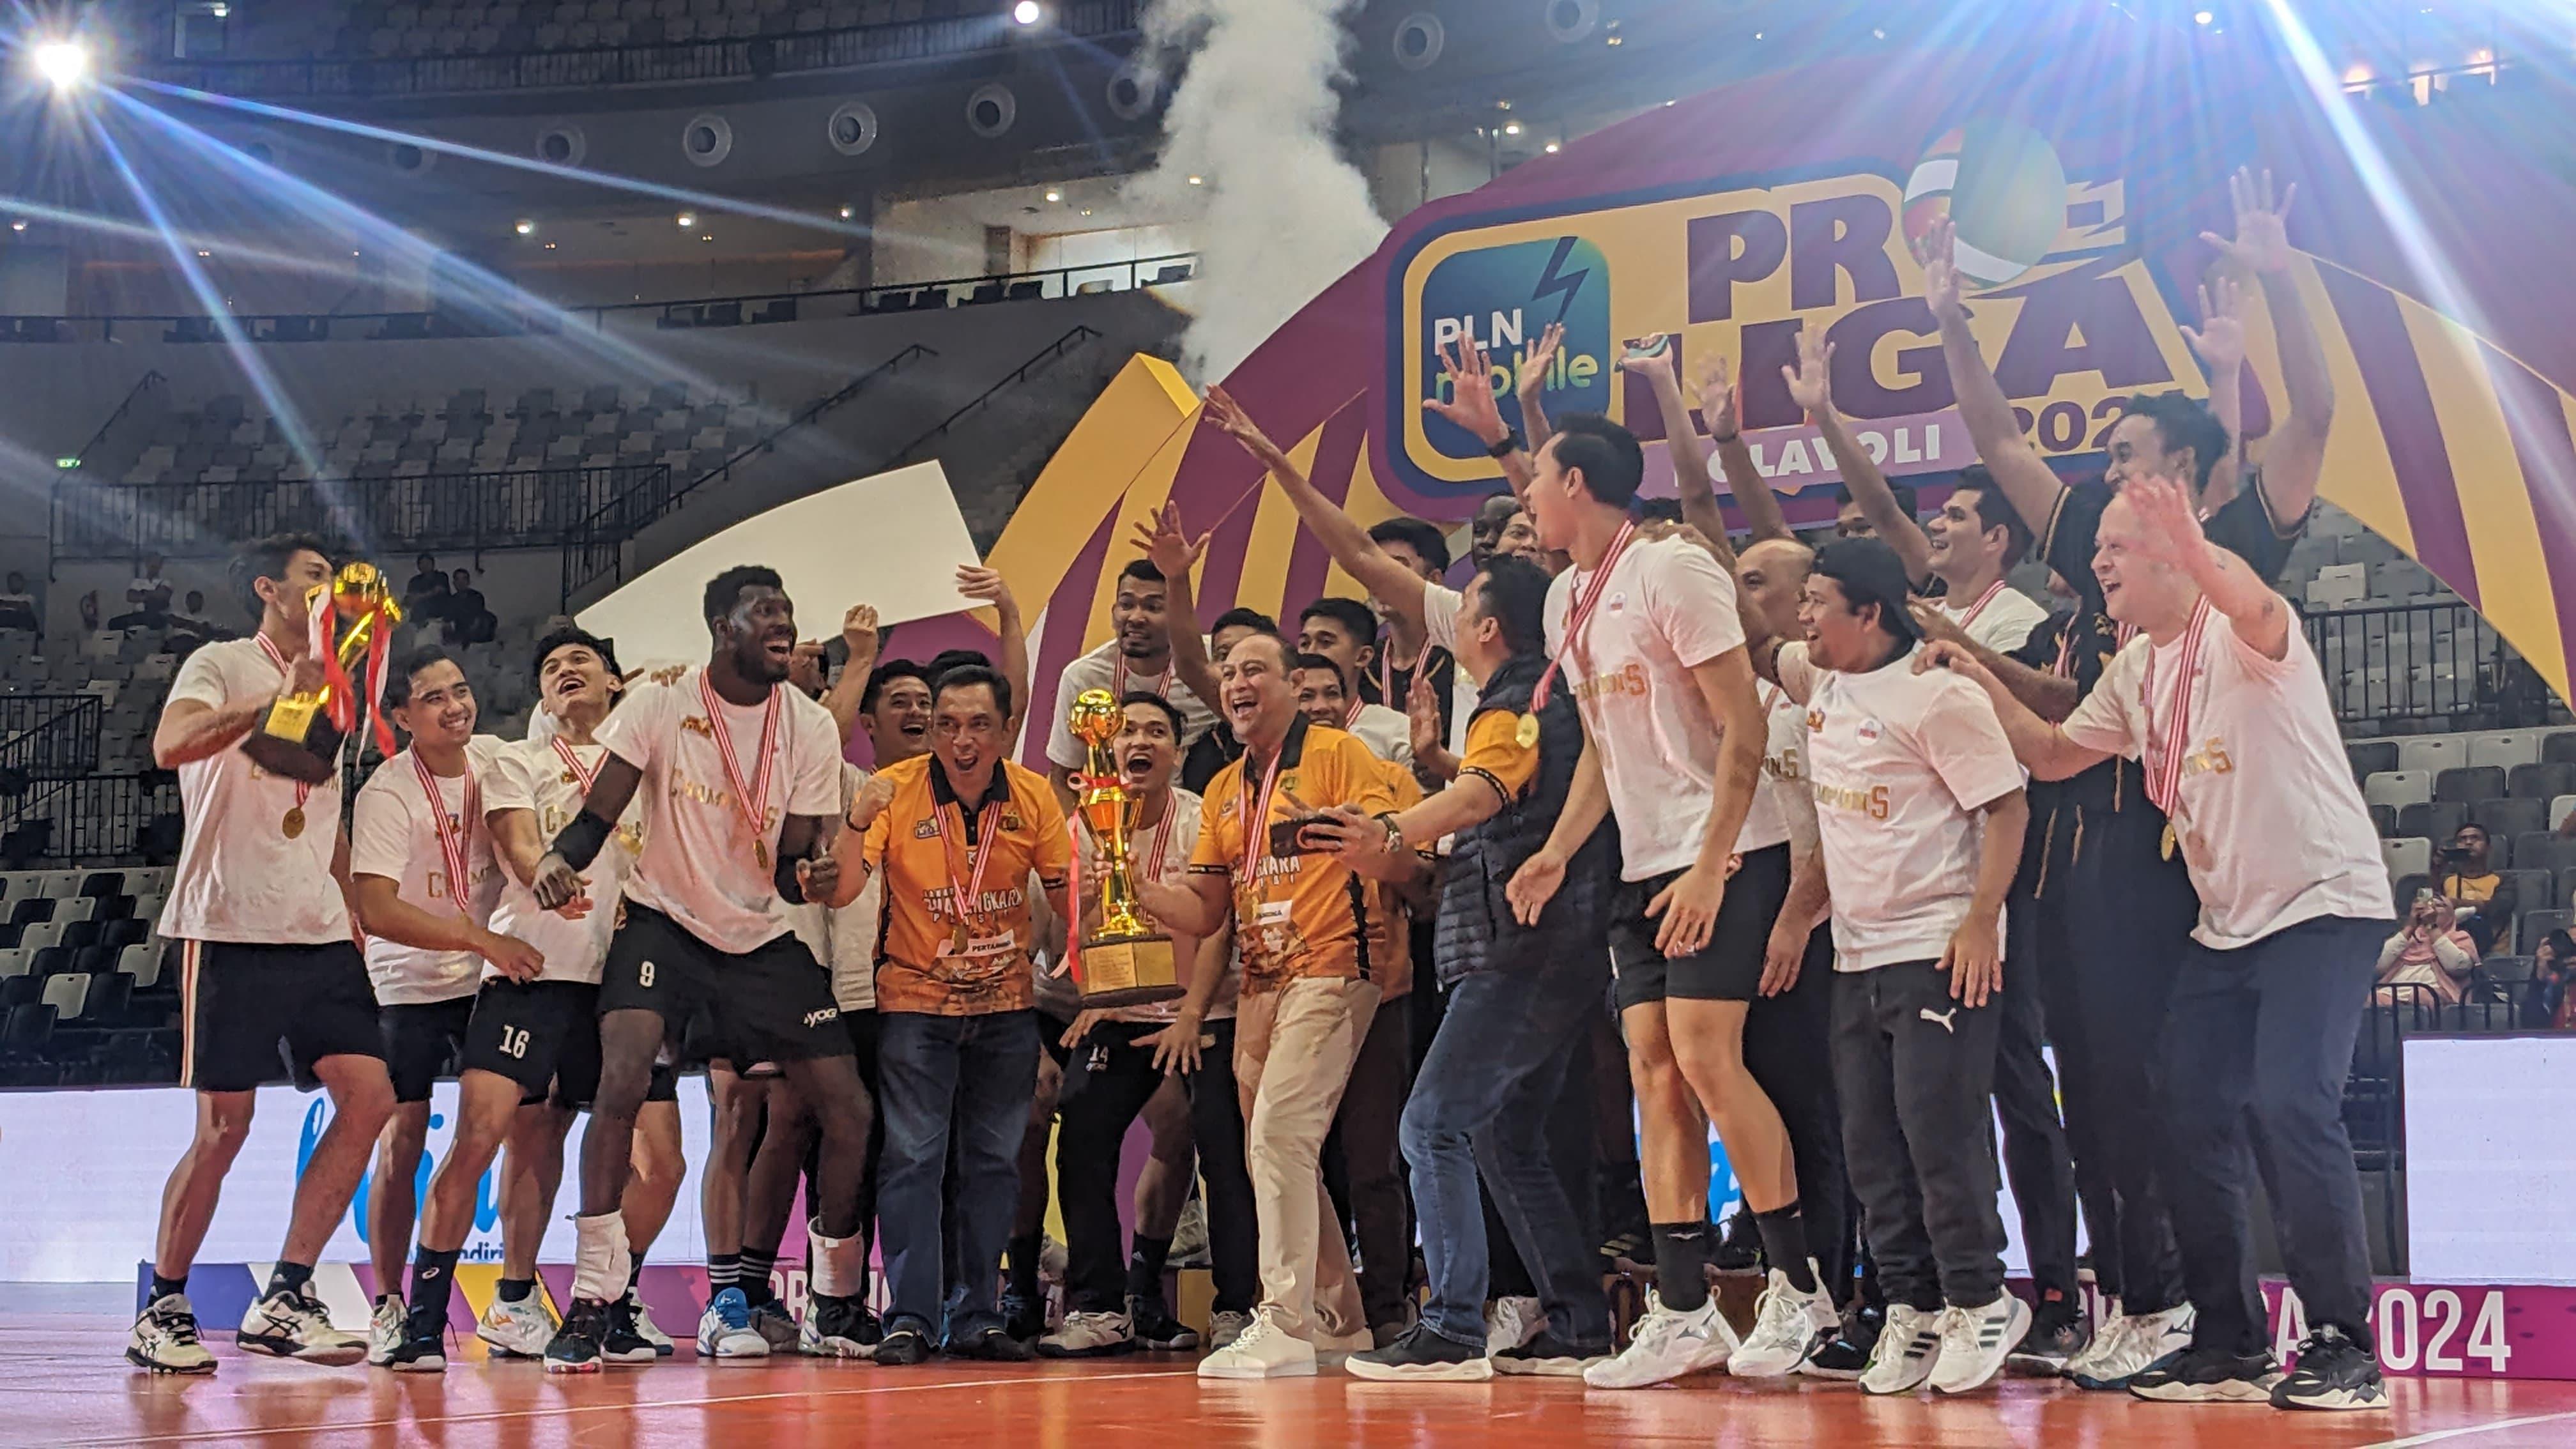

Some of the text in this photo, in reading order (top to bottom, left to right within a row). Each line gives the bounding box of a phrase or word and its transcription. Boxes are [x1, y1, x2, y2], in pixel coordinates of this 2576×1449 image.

[1435, 309, 1522, 355] PLN
[1623, 253, 2175, 441] LIGA
[1436, 345, 1598, 403] oile
[2011, 389, 2184, 452] 02
[1674, 424, 1940, 487] OLAVOLI
[640, 960, 655, 987] 9
[499, 1024, 530, 1059] 16
[1089, 1043, 1109, 1064] 14
[459, 1242, 503, 1260] ndiri
[2366, 1288, 2511, 1372] 024
